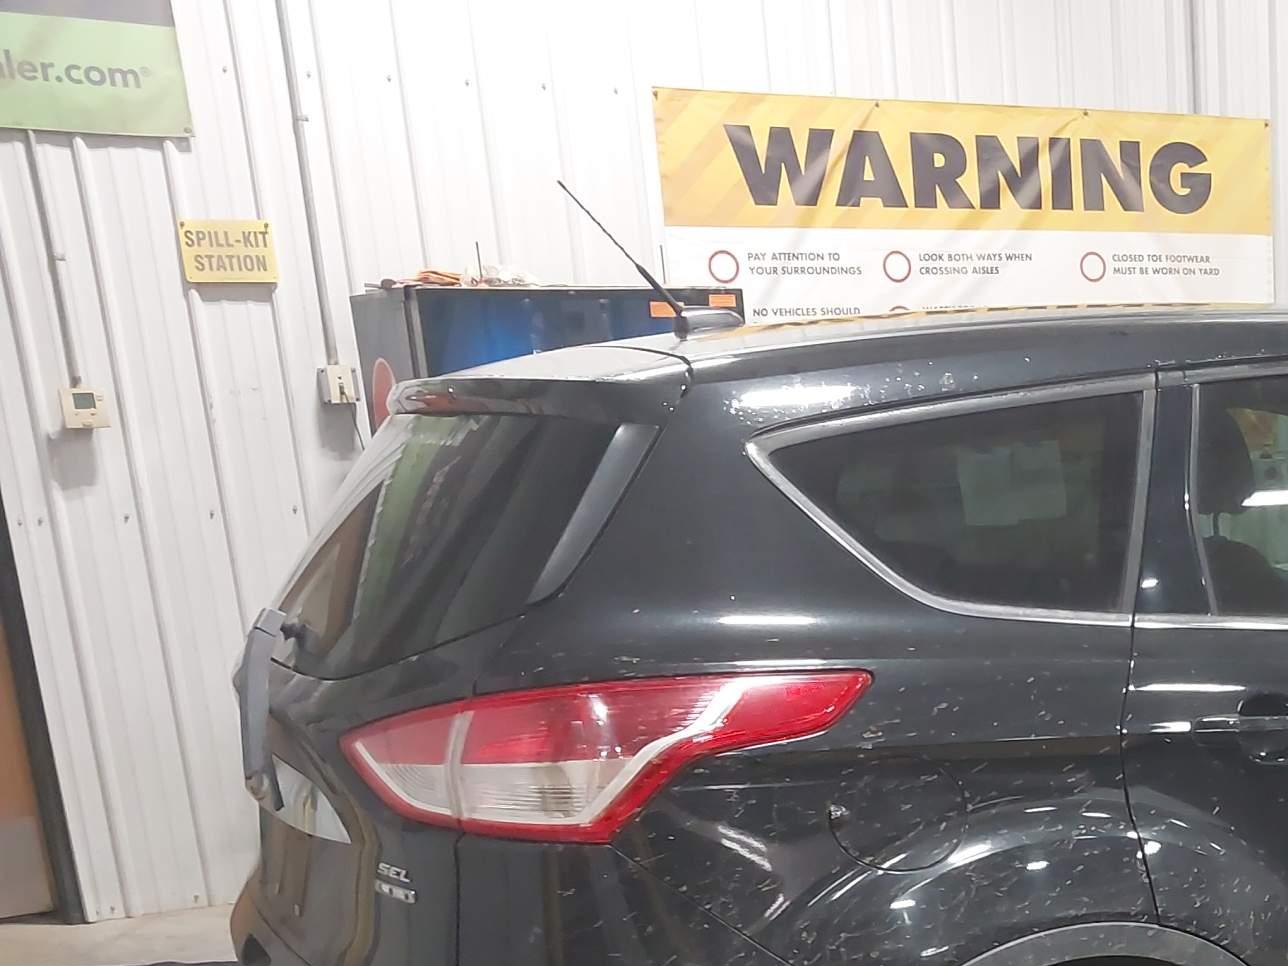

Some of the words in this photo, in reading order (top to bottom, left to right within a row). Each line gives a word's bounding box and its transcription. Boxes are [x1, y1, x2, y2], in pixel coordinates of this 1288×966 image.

[723, 124, 1213, 214] WARNING
[184, 230, 269, 248] SPILL-KIT
[747, 252, 767, 262] PAY
[771, 252, 825, 262] ATTENTION
[828, 252, 841, 262] TO
[919, 253, 944, 262] LOOK
[947, 253, 974, 262] BOTH
[976, 253, 1003, 262] WAYS
[1005, 253, 1033, 262] WHEN
[1112, 254, 1145, 263] CLOSED
[1147, 254, 1163, 263] TOE
[1166, 254, 1211, 264] FOOTWEAR
[194, 254, 267, 272] STATION
[749, 266, 779, 276] YOUR
[781, 266, 863, 276] SURROUNDINGS
[920, 266, 969, 275] CROSSING
[971, 266, 1000, 275] AISLES
[1113, 267, 1137, 276] MUST
[1140, 267, 1150, 276] BE
[1152, 267, 1181, 276] WORN
[1183, 268, 1197, 277] ON
[1199, 268, 1221, 277] YARD
[753, 308, 769, 317] NO
[772, 307, 818, 317] VEHICLES
[821, 306, 861, 316] SHOULD
[377, 862, 411, 883] SEL
